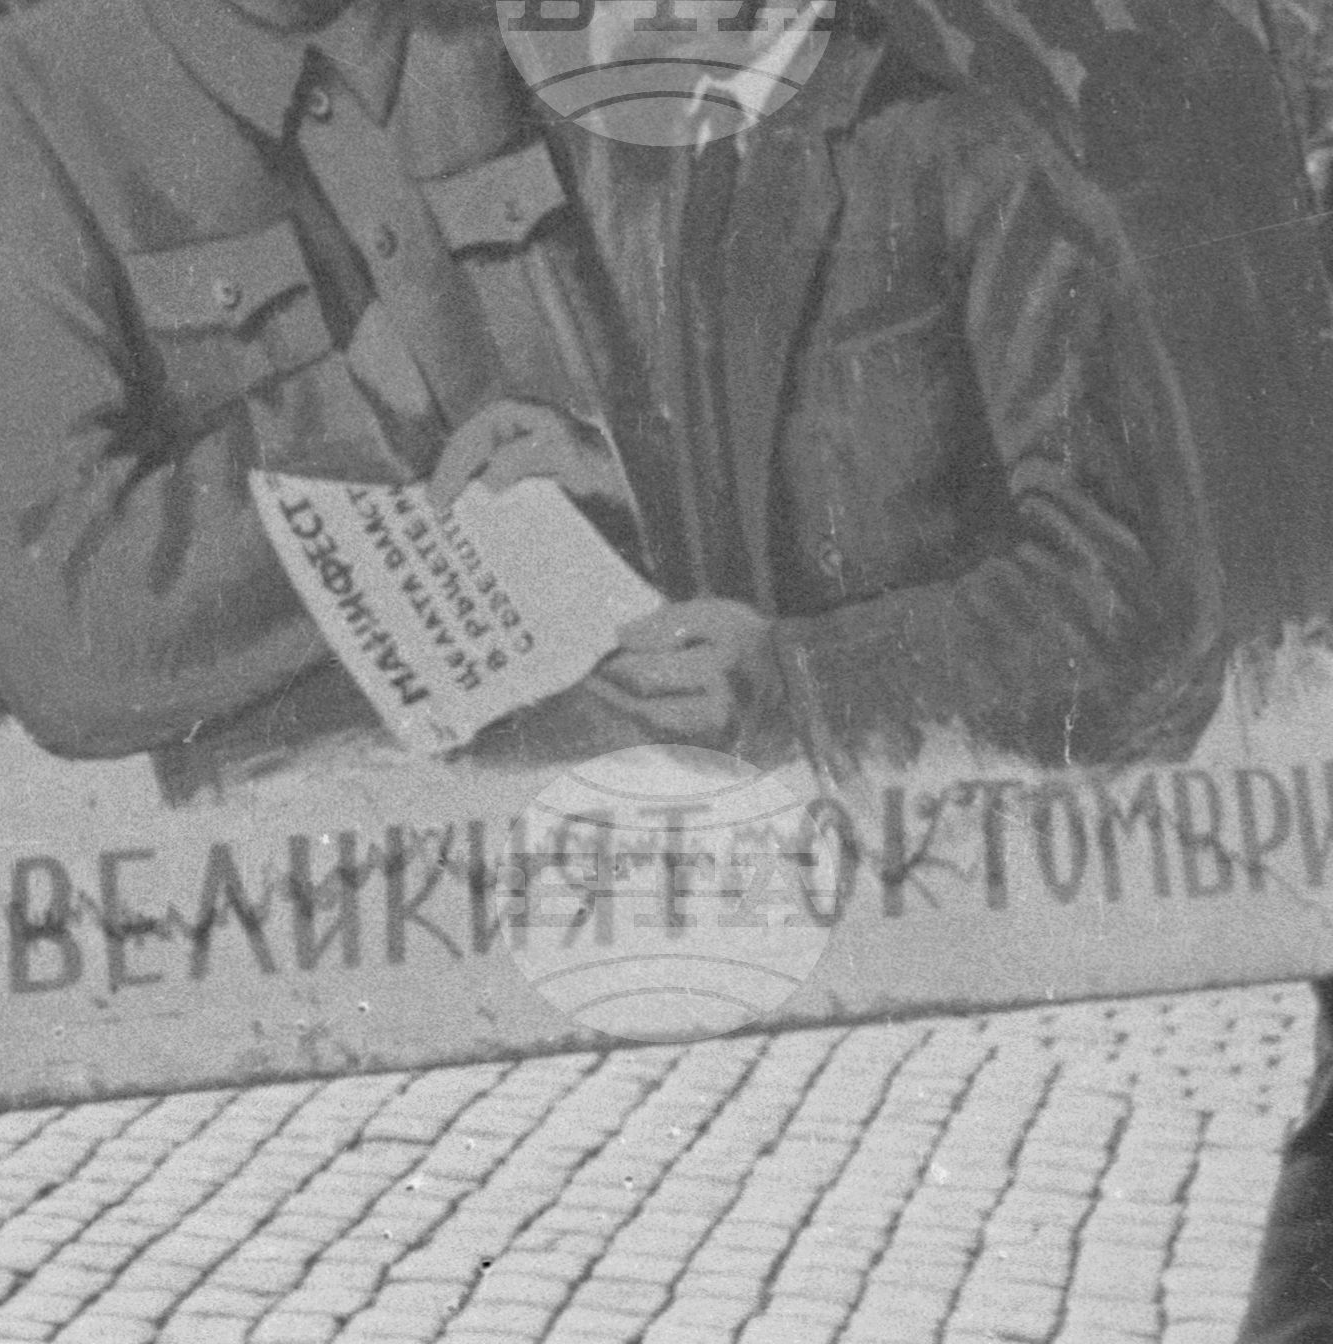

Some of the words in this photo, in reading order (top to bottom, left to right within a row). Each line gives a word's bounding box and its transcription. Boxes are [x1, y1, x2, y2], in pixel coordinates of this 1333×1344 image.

[280, 499, 430, 706] МАНИФЕСТ
[401, 574, 481, 690] ЦЕЛАТА
[7, 802, 712, 994] ВЕЛИКИЯТ
